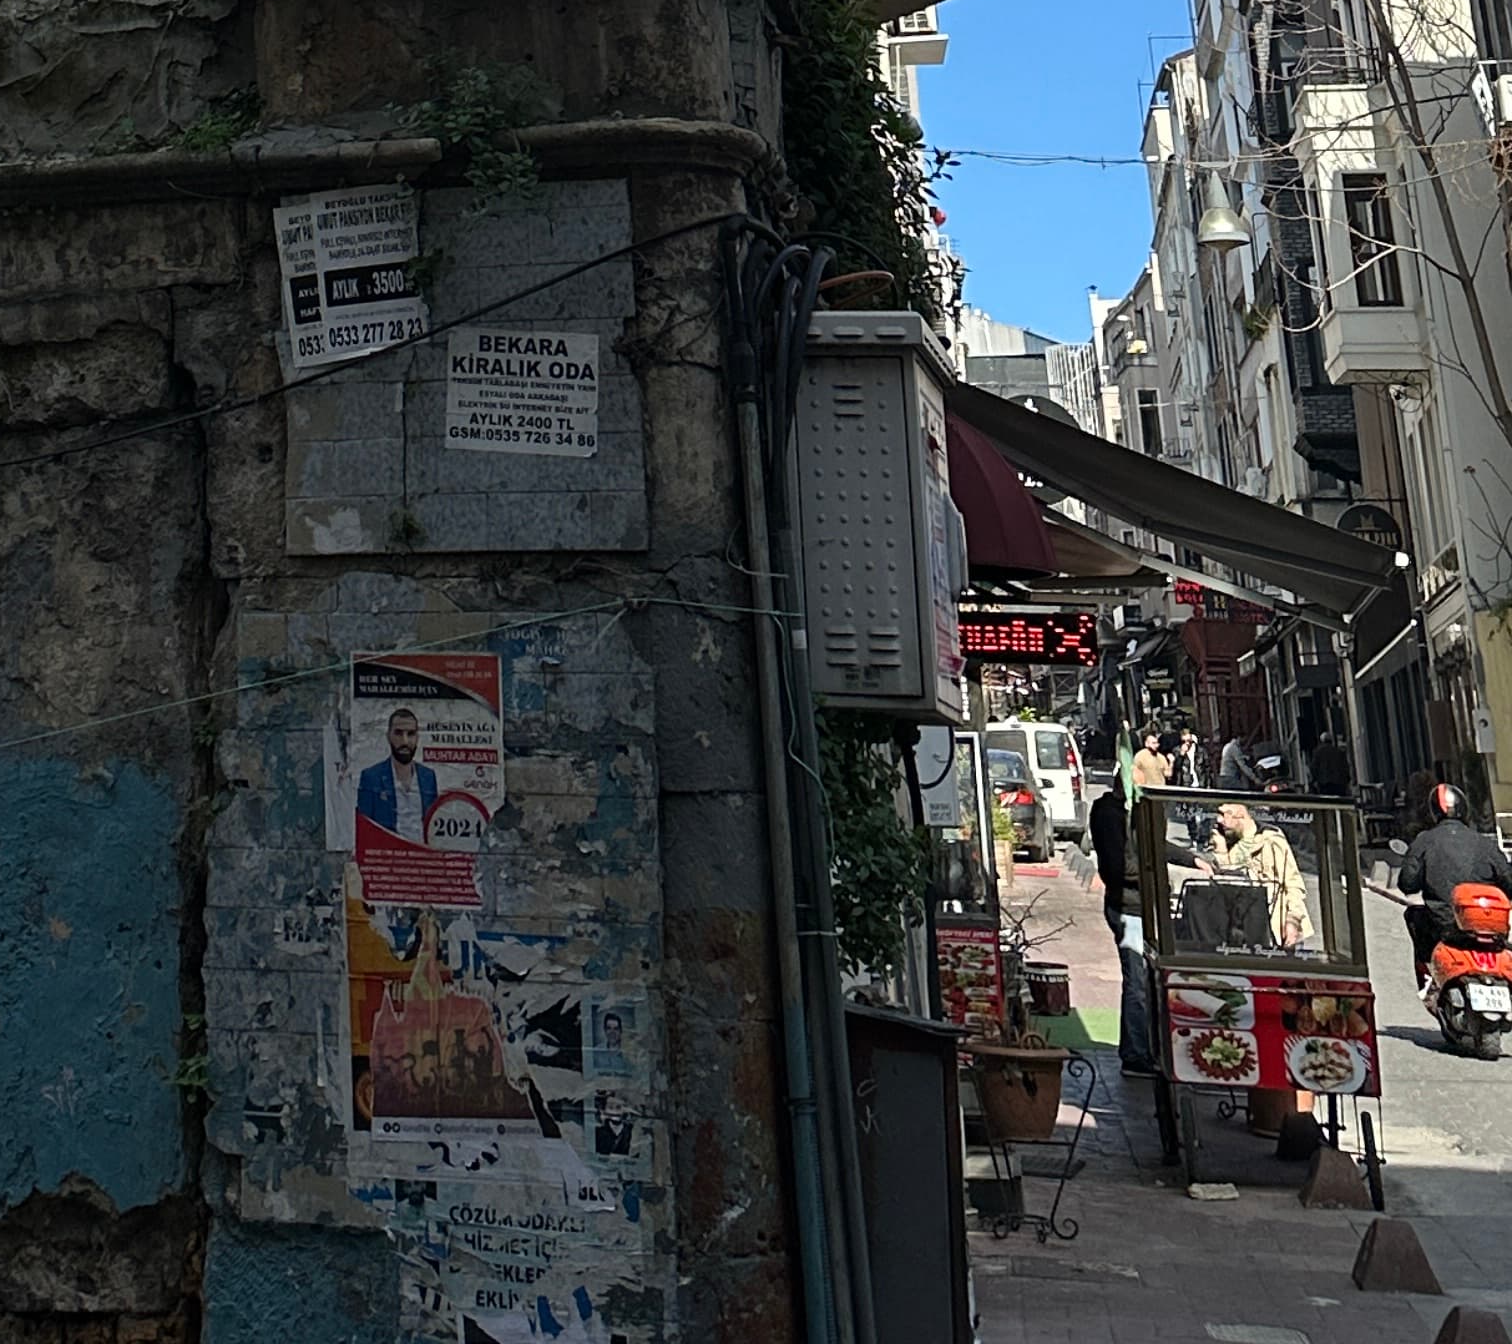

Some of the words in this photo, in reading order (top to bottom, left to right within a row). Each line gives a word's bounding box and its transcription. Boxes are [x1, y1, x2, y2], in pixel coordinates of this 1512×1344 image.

[332, 277, 360, 301] AYLIK
[371, 269, 405, 296] 3500
[329, 324, 359, 347] 0533
[362, 322, 384, 343] 277
[388, 319, 404, 340] 28
[407, 317, 424, 339] 23
[479, 335, 568, 357] BEKARA
[452, 353, 541, 378] KİRALIK
[549, 362, 595, 380] ODA
[470, 413, 513, 427] AYLIK
[517, 416, 552, 429] 2400
[557, 418, 575, 430] TL
[526, 431, 551, 444] 726
[556, 432, 573, 445] 34
[424, 750, 468, 762] MUHTAR
